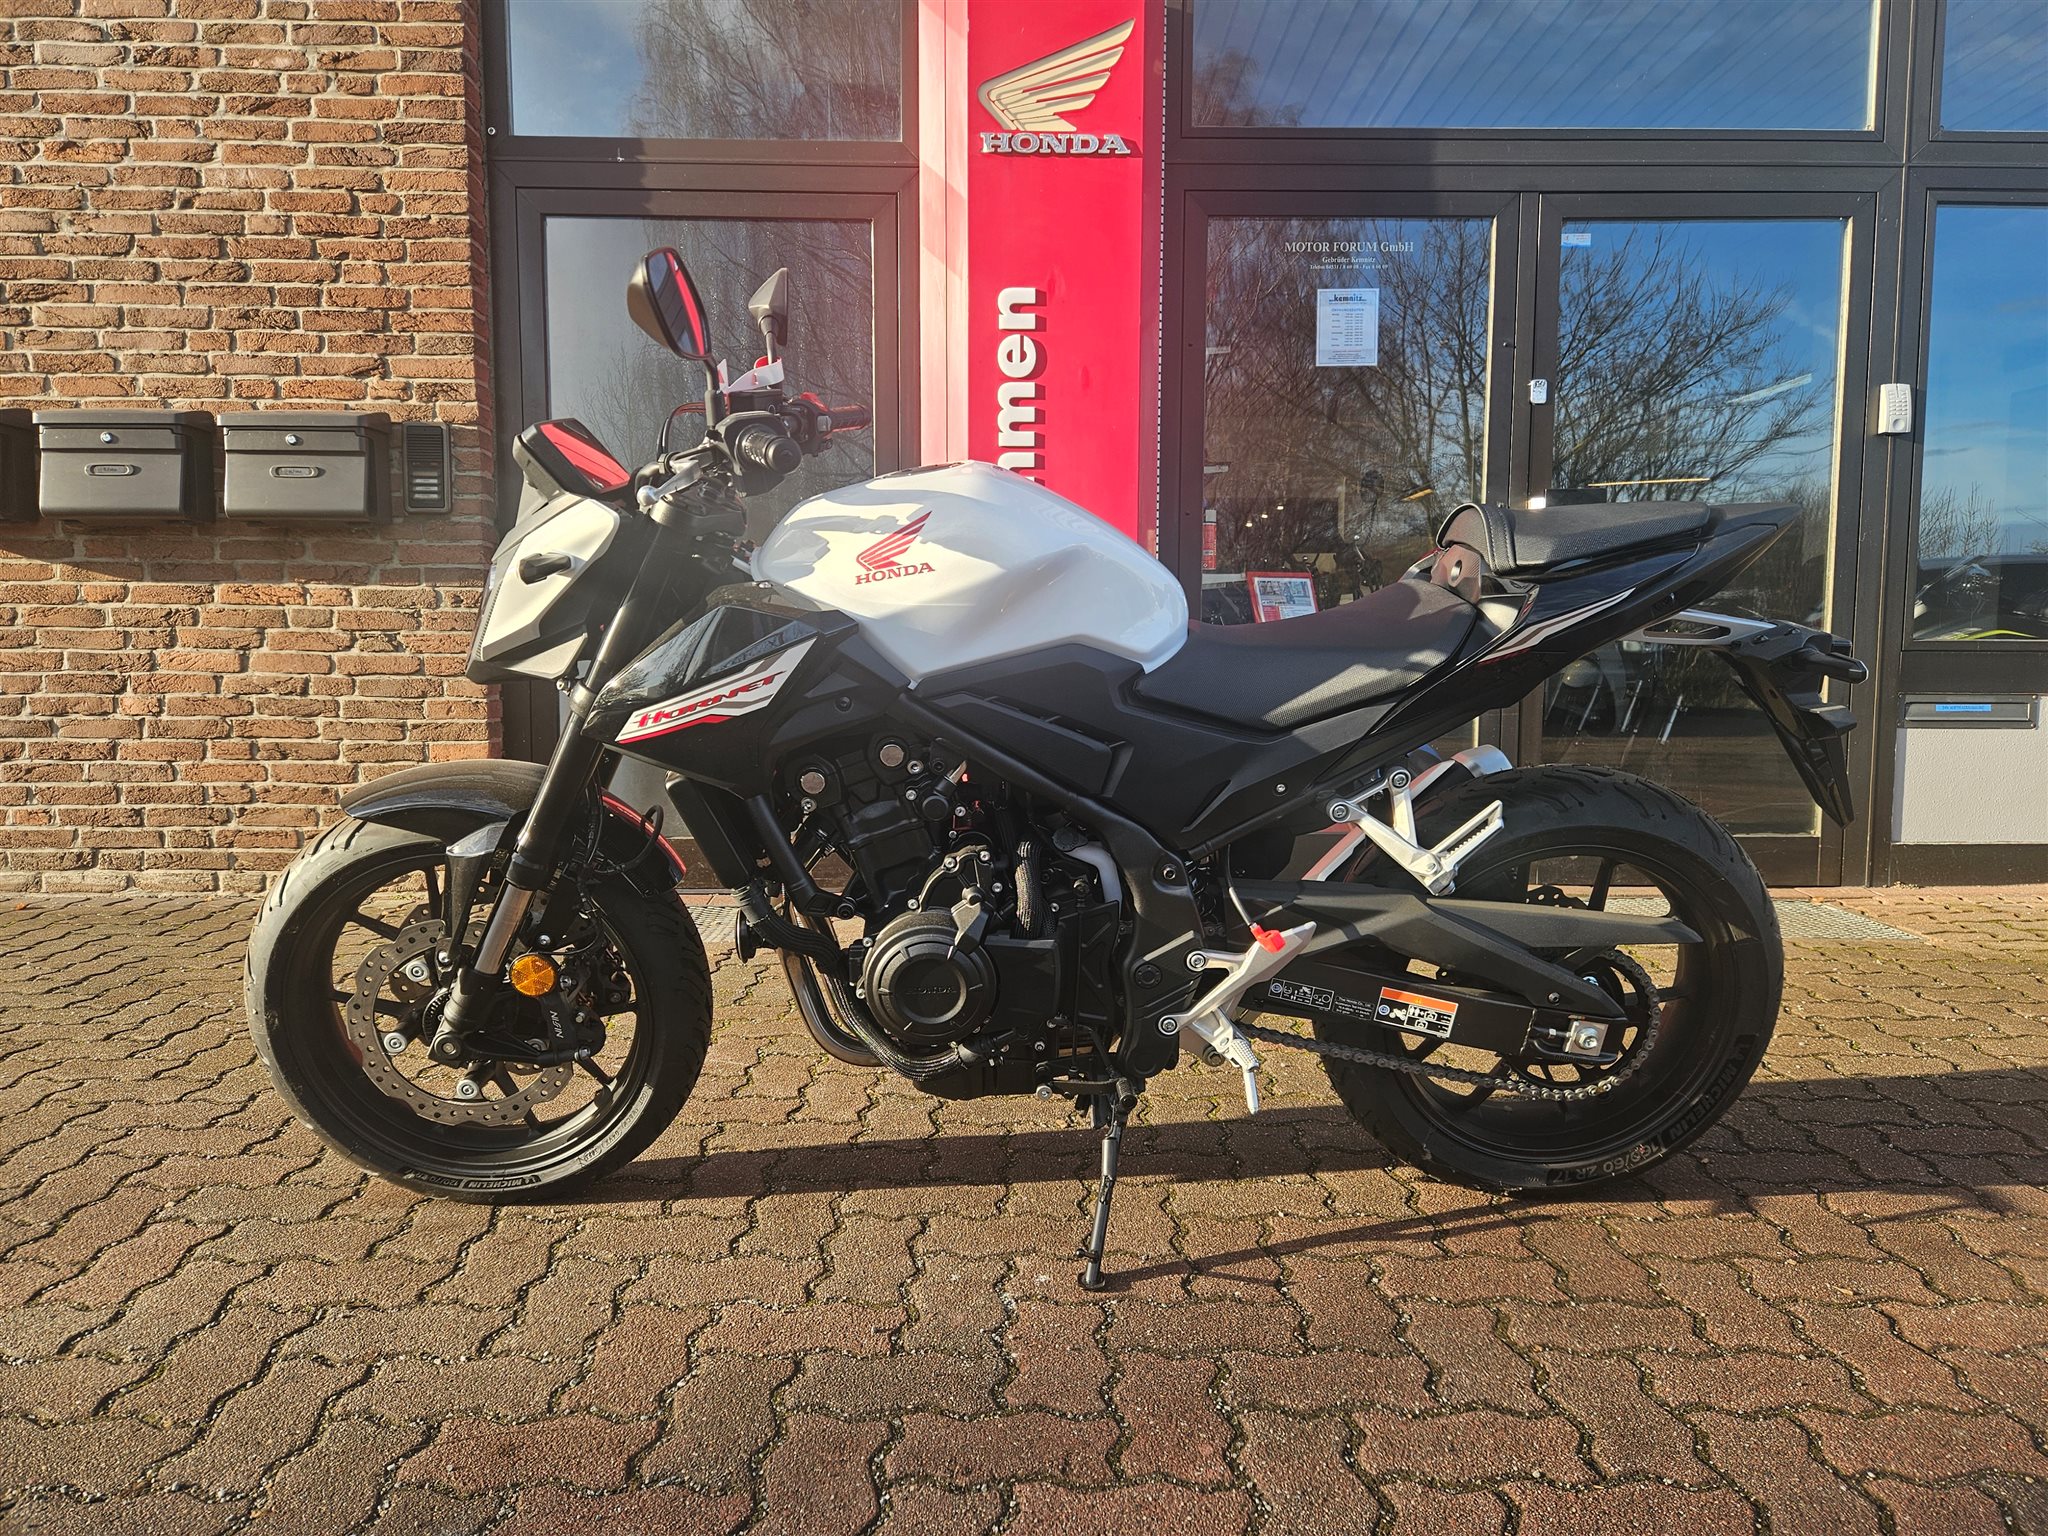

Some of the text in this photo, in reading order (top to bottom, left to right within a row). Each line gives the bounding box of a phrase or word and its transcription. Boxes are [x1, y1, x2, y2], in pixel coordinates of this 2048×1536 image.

[980, 132, 1131, 154] HONDA
[1284, 241, 1414, 253] MOTOR FORUM GmbH
[855, 561, 936, 585] HONDA
[467, 1178, 523, 1189] MICHELIN
